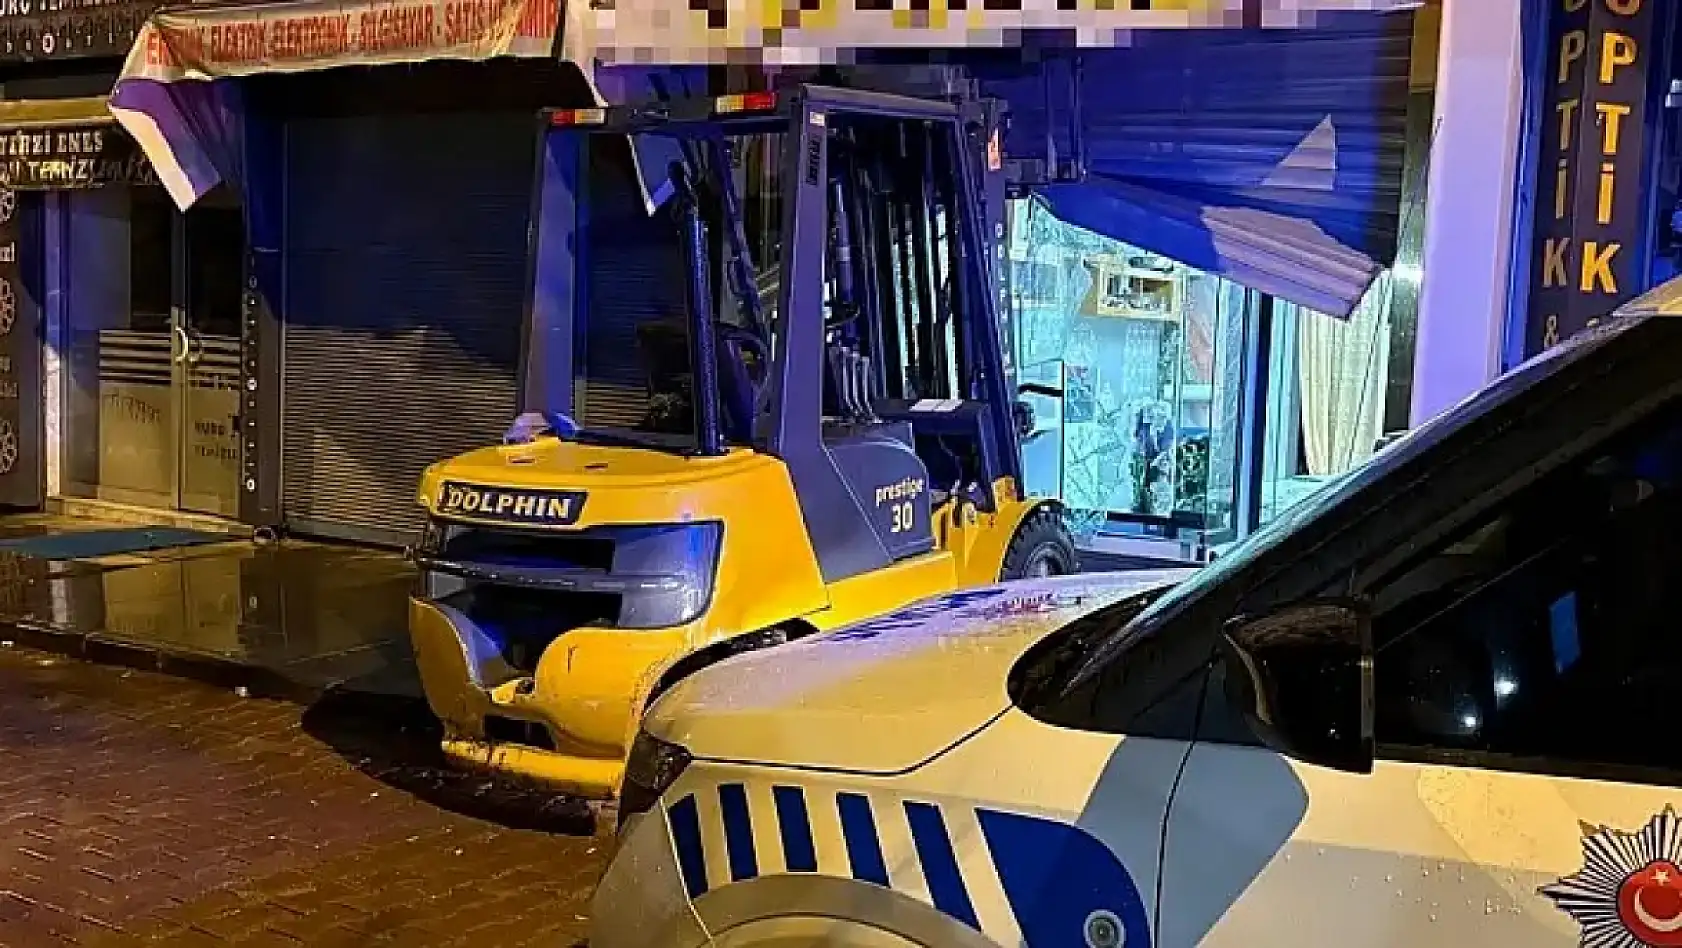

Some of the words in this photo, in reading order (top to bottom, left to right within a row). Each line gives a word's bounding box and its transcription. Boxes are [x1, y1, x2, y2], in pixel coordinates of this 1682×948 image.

[447, 488, 571, 519] DOLPHIN
[875, 475, 923, 508] prestige
[891, 501, 913, 533] 30
